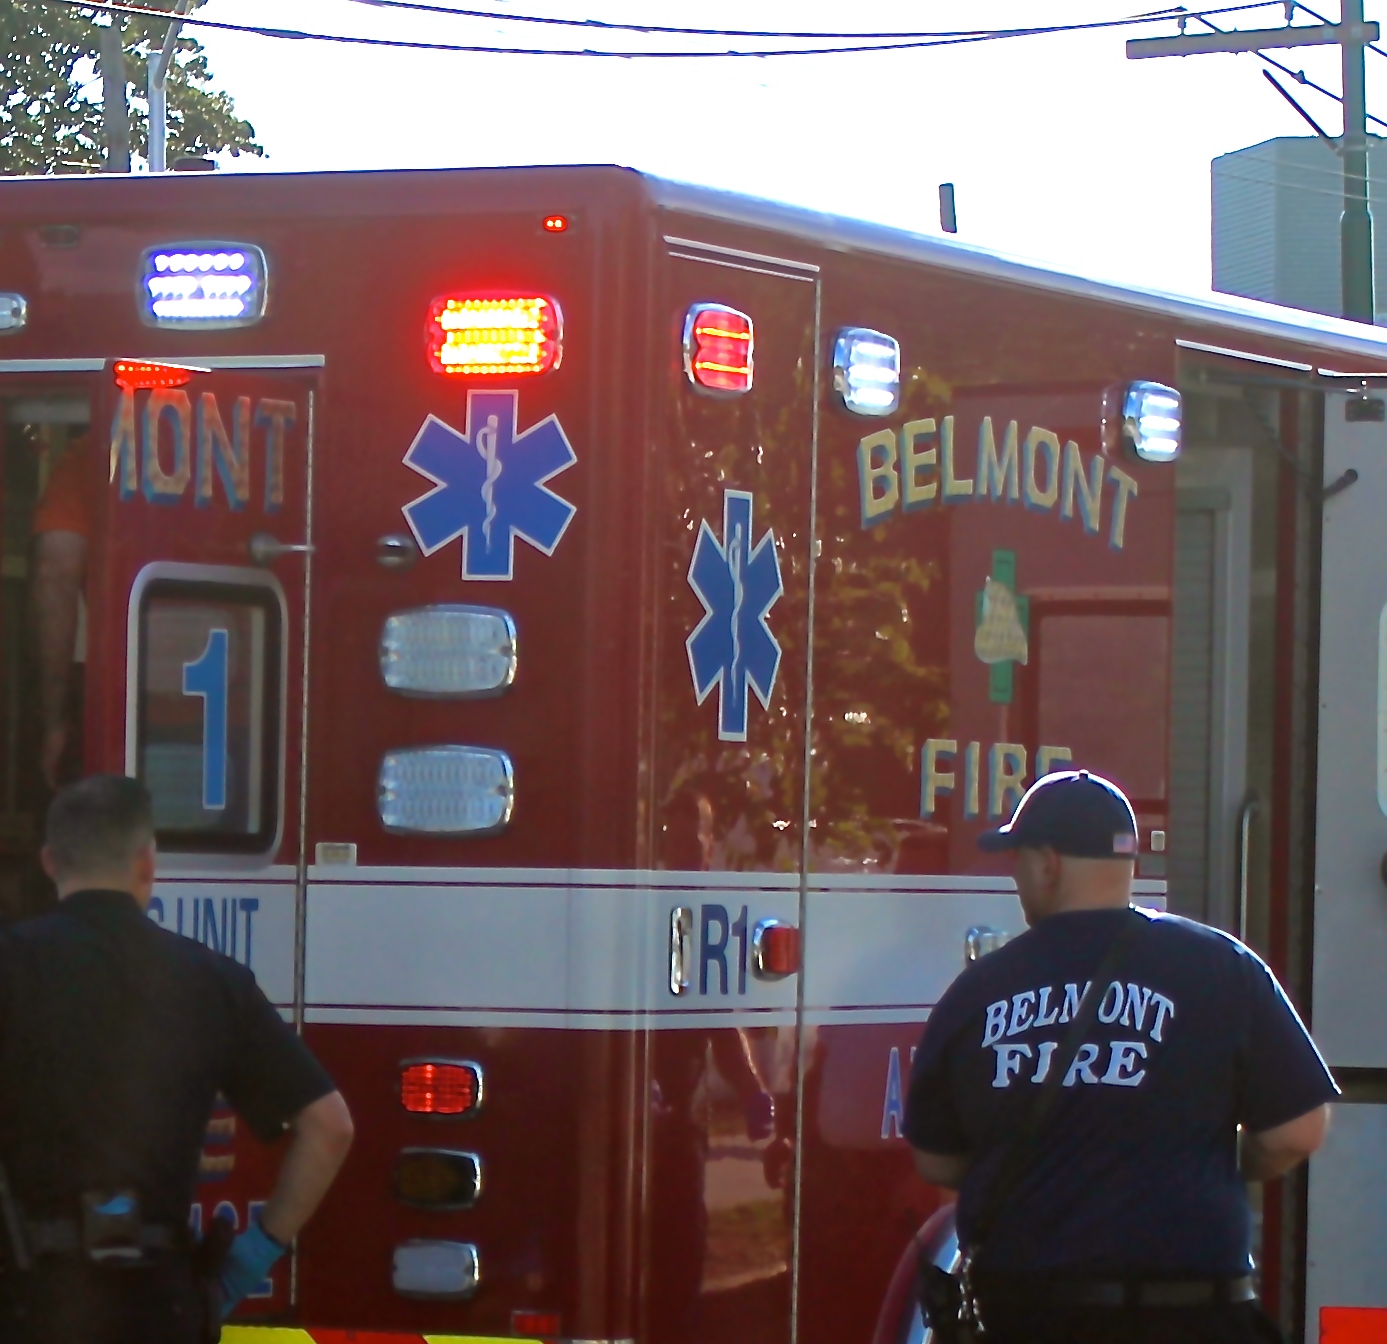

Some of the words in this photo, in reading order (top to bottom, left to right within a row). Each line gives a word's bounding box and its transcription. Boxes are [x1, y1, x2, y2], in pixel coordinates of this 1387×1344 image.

[856, 414, 1138, 552] BELMONT
[698, 904, 748, 996] R1
[991, 1040, 1148, 1088] FIRE
